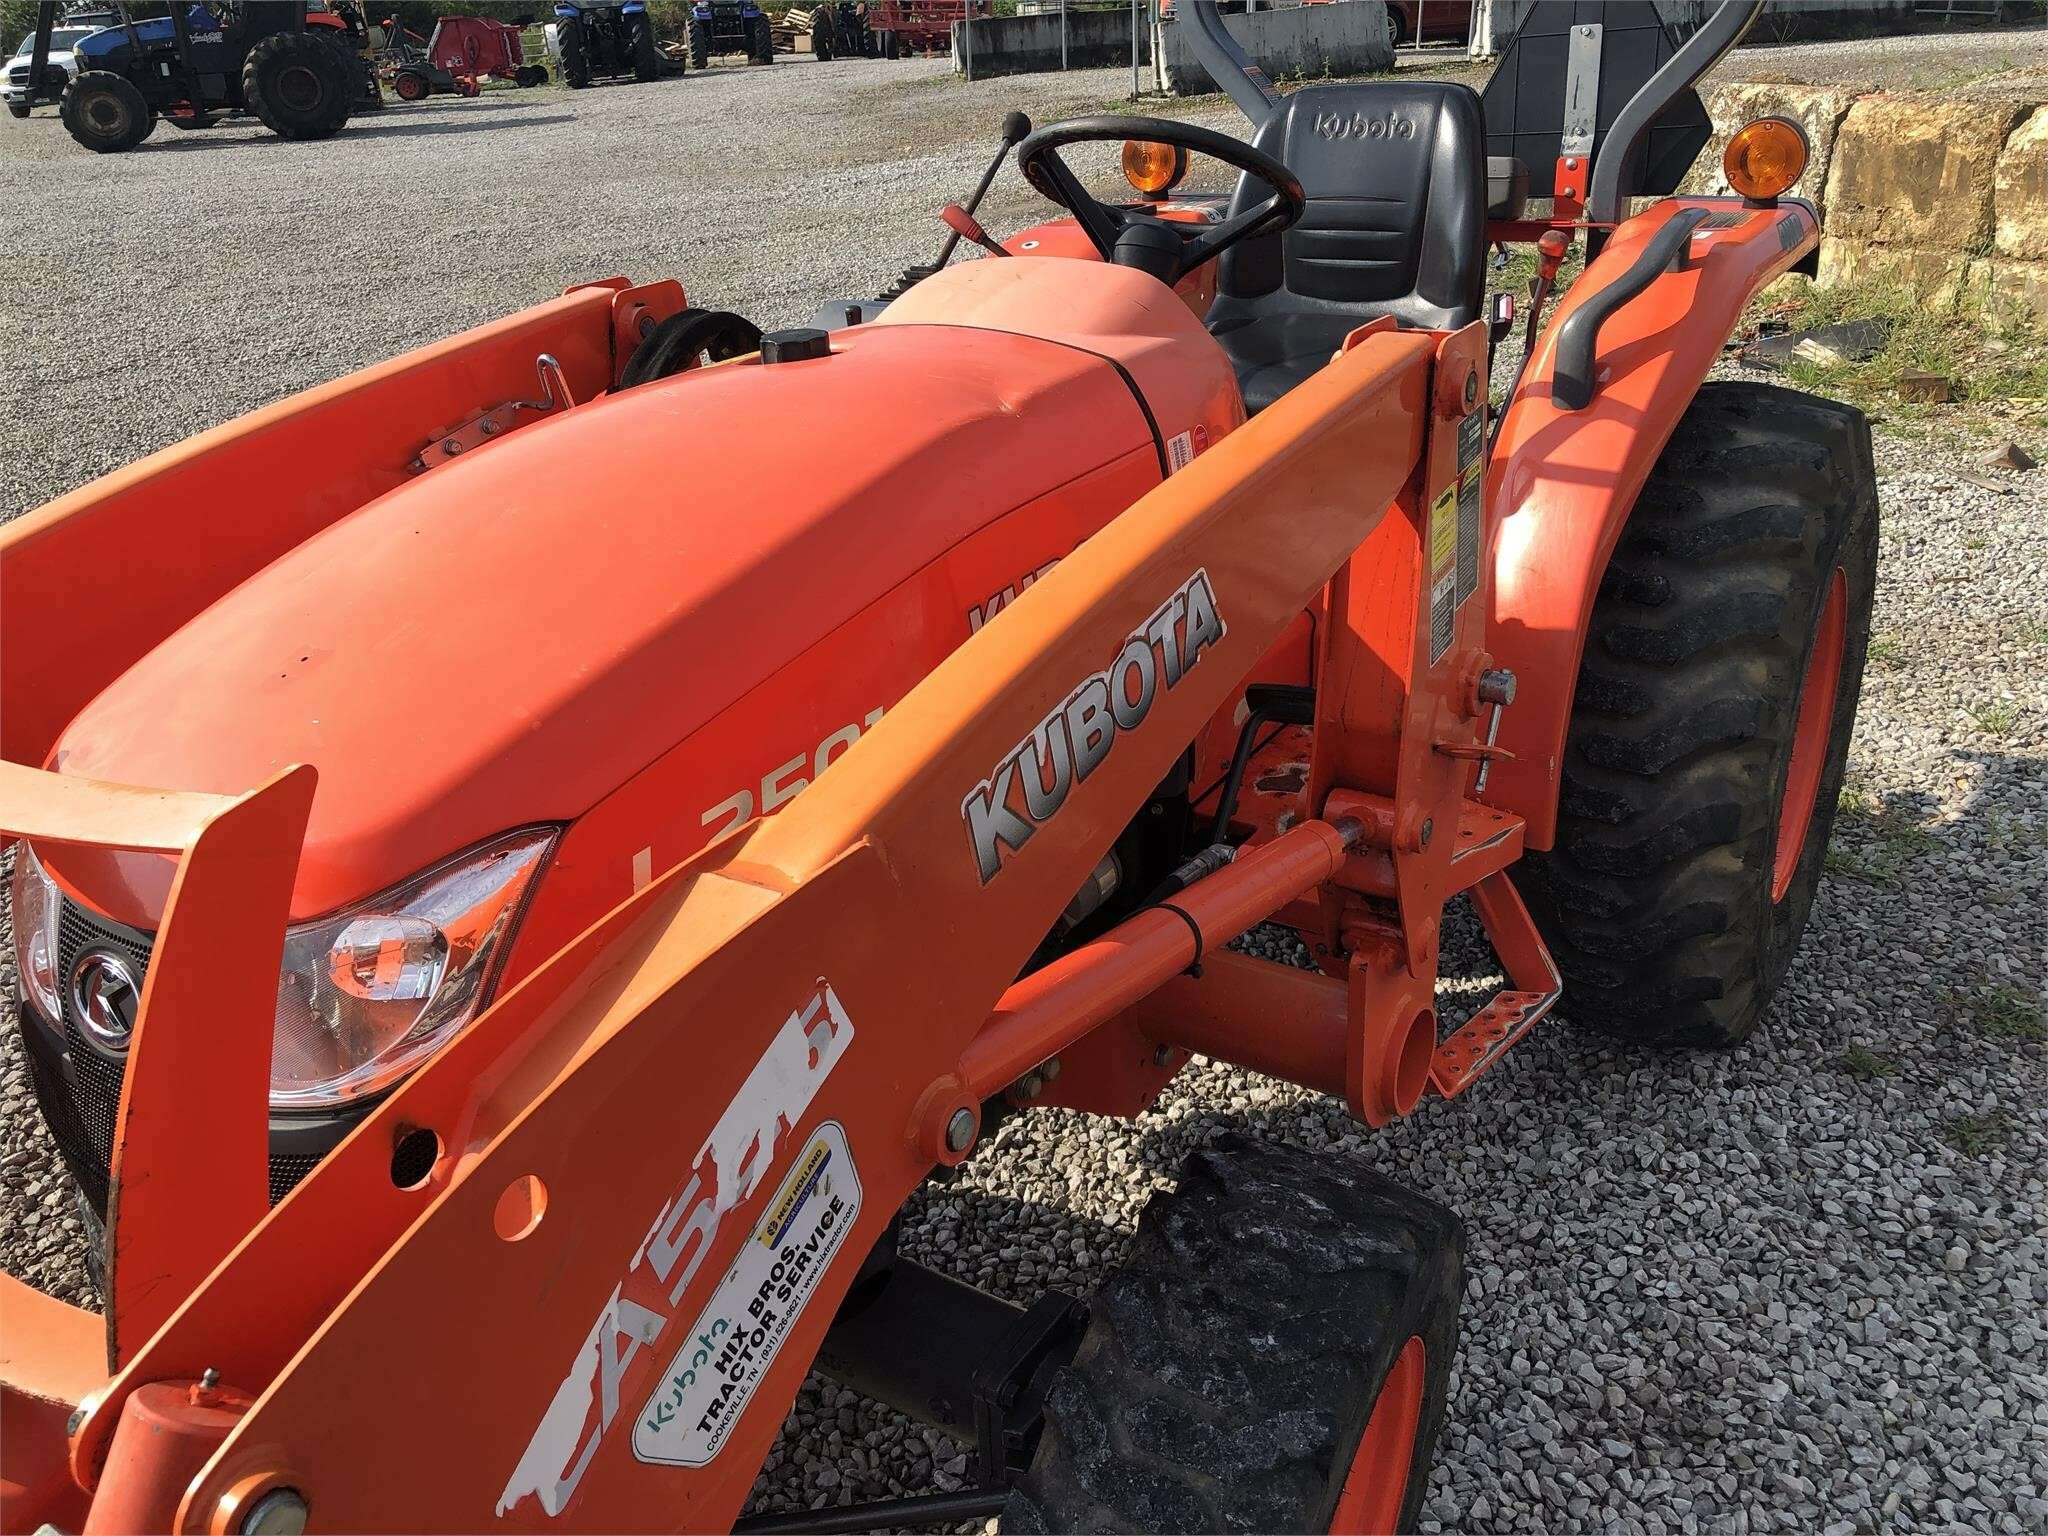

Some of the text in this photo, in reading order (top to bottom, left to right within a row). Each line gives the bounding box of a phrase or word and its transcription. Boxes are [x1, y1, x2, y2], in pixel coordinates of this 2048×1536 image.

[1313, 110, 1417, 140] Kubota
[701, 705, 884, 848] 250
[966, 570, 1224, 886] KUBOTA
[777, 1148, 823, 1221] NEW HOLLAND
[646, 1318, 731, 1433] Kubota
[696, 1194, 844, 1433] TRACTOR SERVICE
[706, 1203, 856, 1451] COOKEVILLE, TN (931) 526-9621 www.hixtractor.com
[714, 1243, 801, 1375] HIX BROS.
